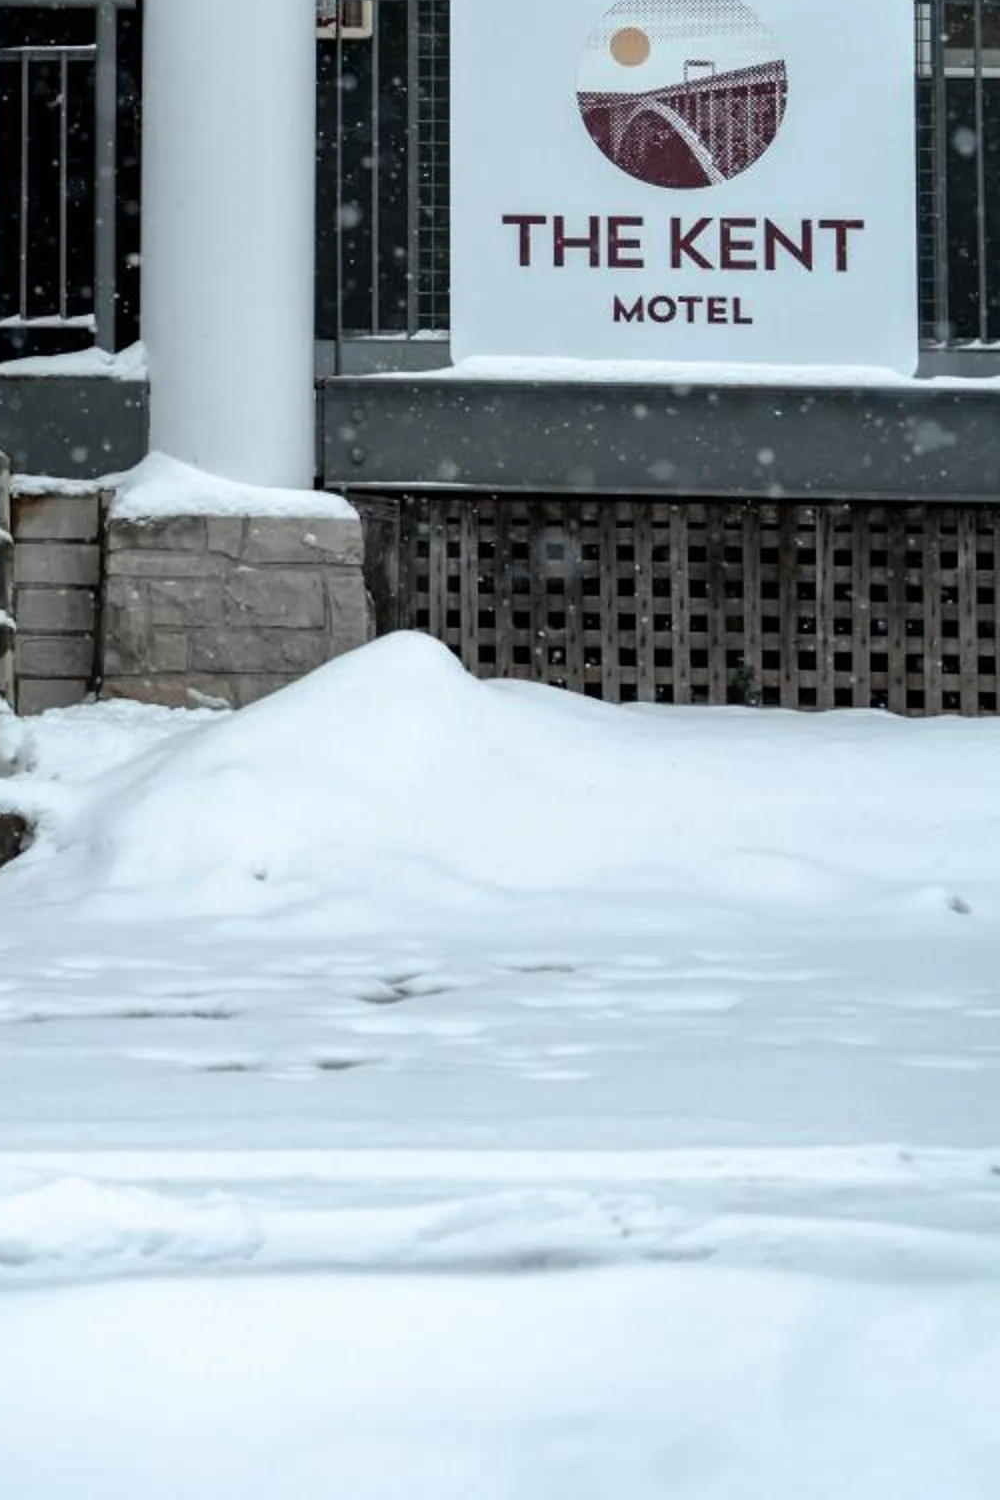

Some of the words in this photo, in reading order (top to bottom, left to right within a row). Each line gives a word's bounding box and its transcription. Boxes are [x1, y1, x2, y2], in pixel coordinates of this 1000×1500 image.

[501, 214, 645, 269] THE
[669, 216, 865, 273] KENT
[612, 295, 753, 325] MOTEL
